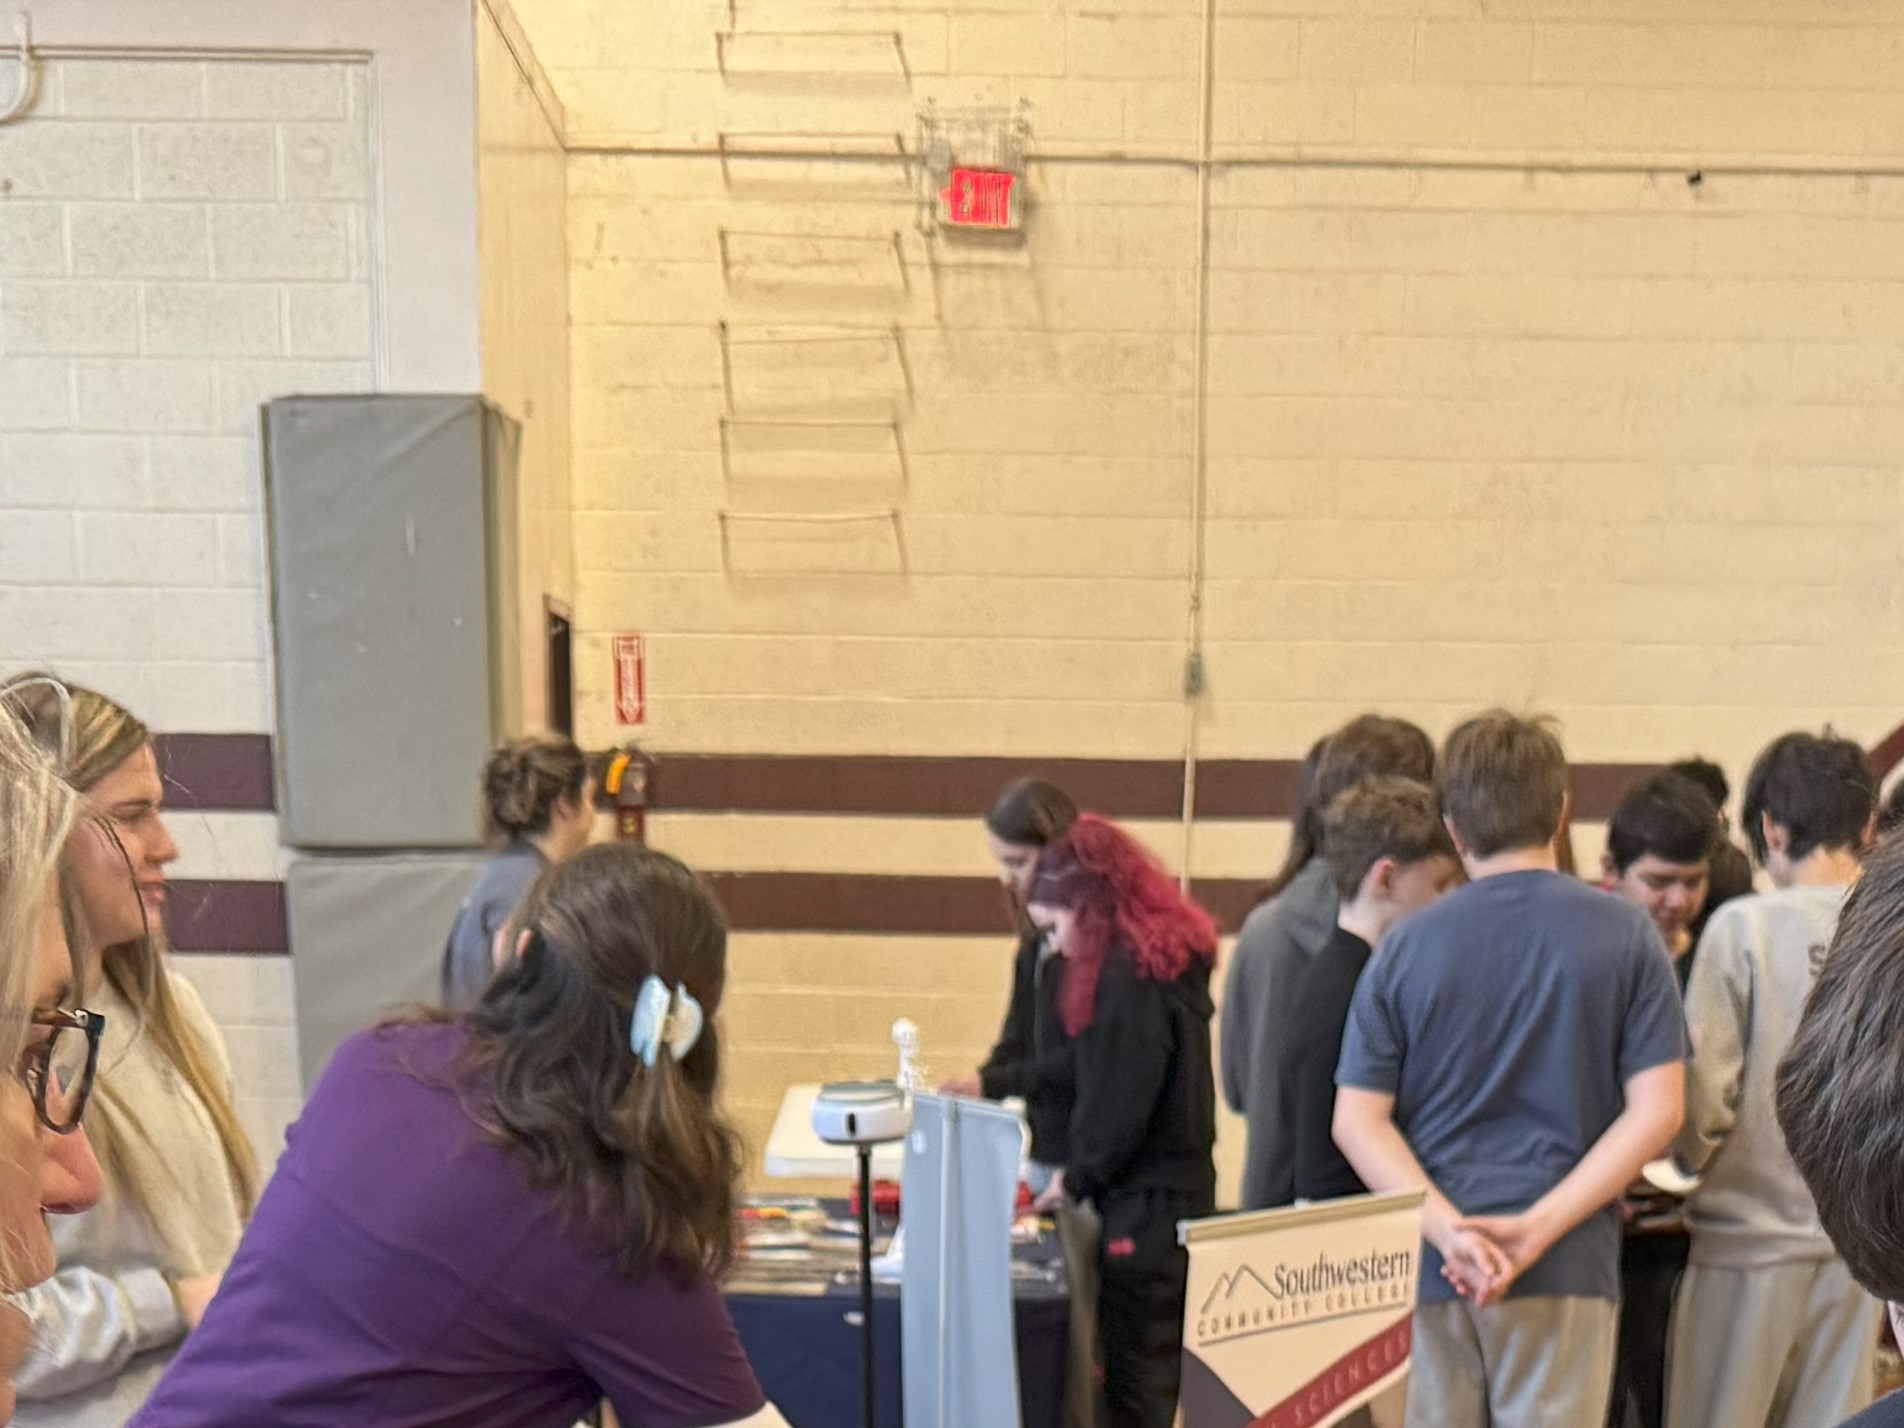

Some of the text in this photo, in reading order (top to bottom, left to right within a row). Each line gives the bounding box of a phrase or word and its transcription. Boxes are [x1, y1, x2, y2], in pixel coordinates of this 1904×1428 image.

[1274, 1249, 1410, 1300] Southwestern
[1197, 1281, 1411, 1338] COMMUNITY COLLEGE
[1295, 1329, 1408, 1420] SCIENCES
